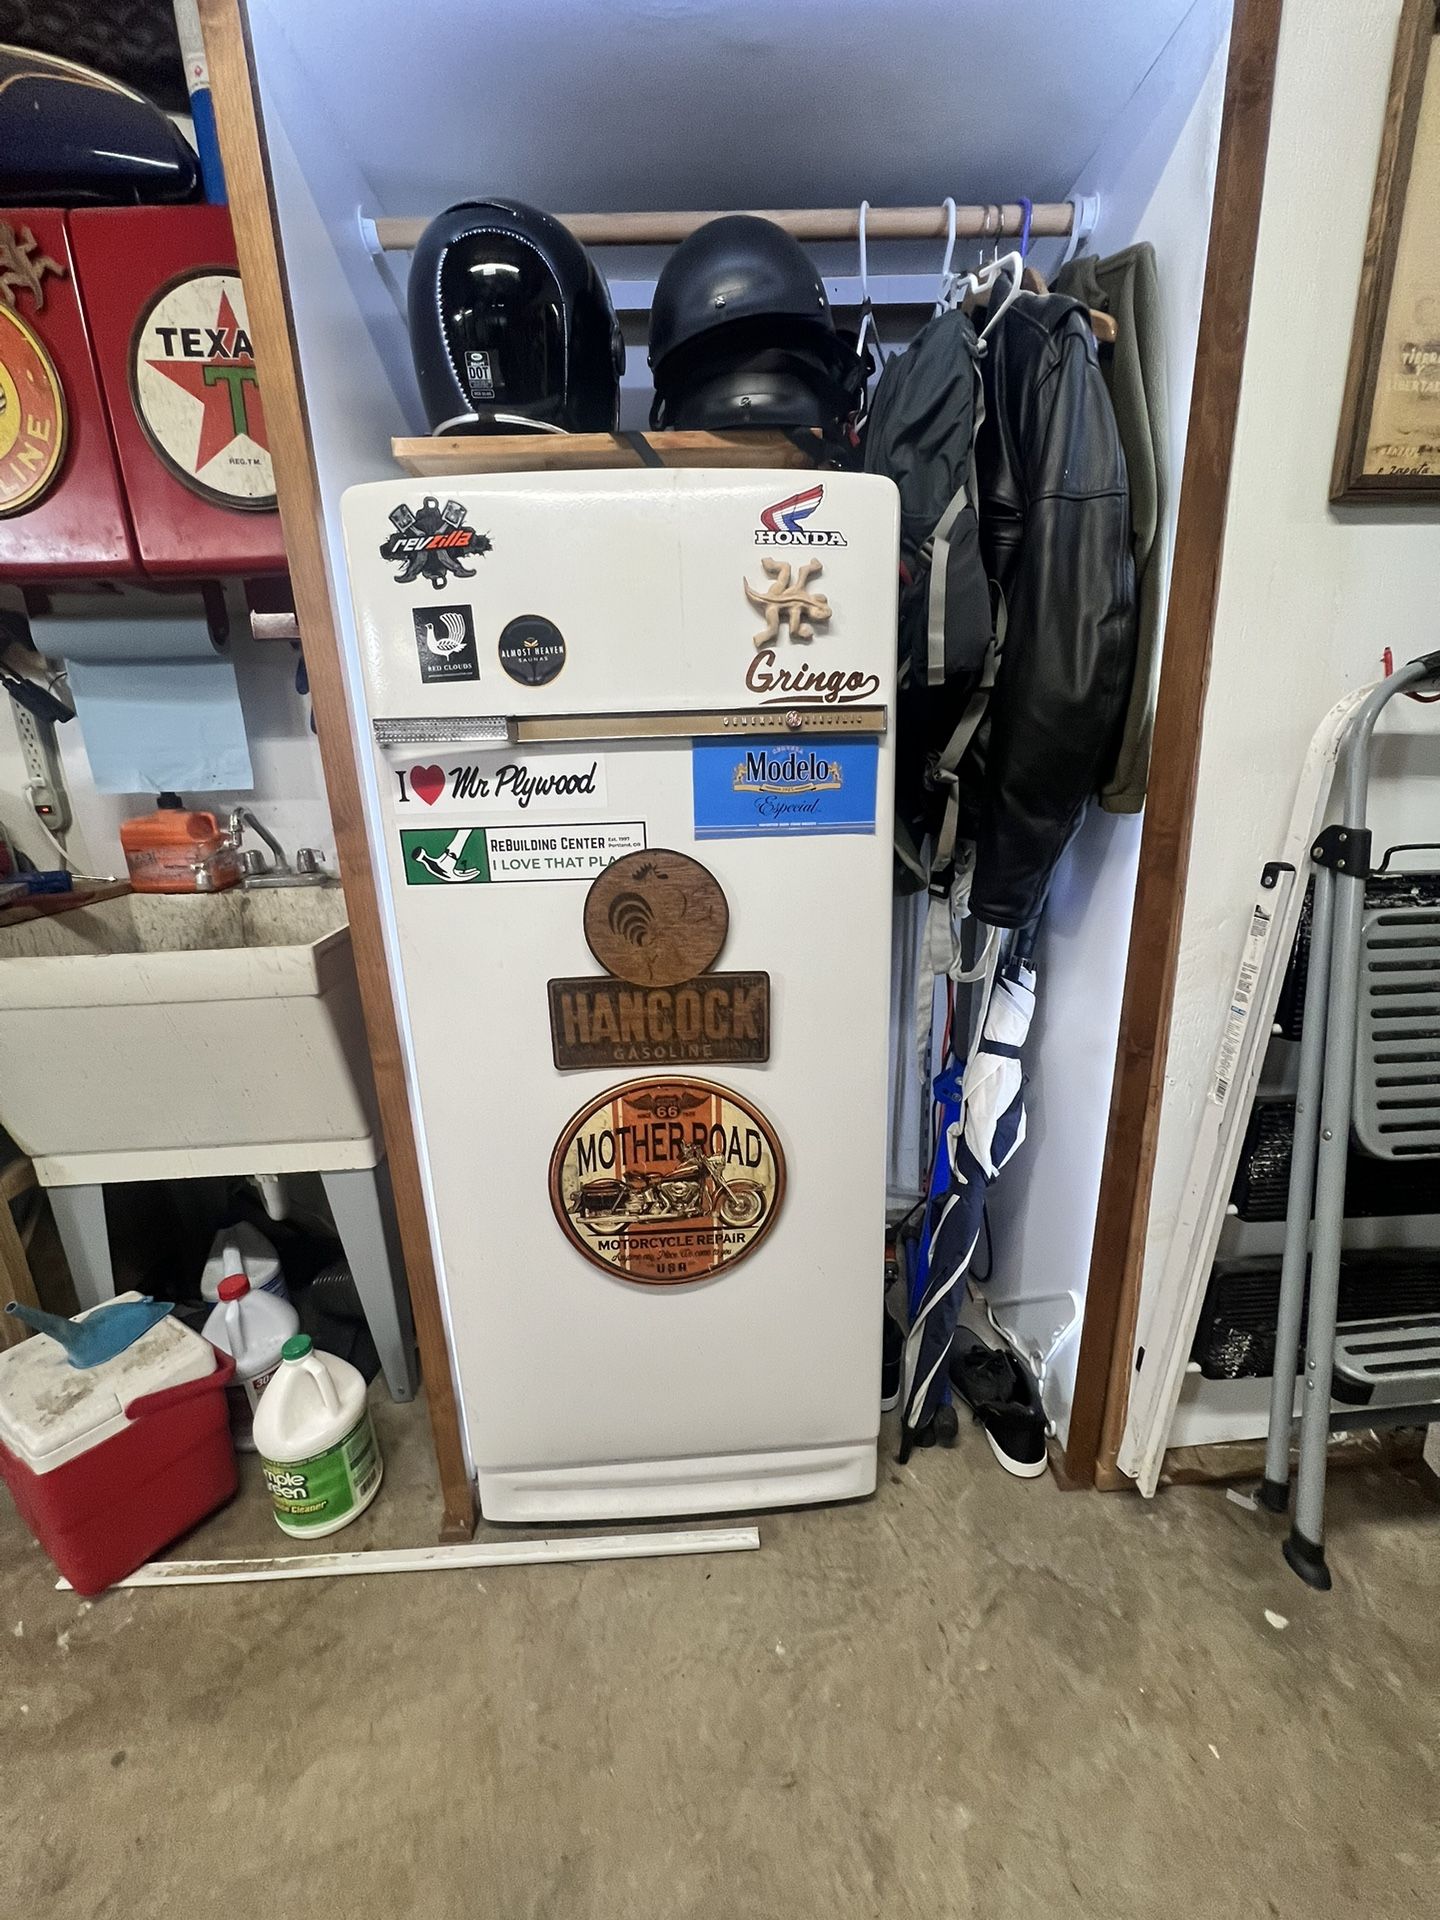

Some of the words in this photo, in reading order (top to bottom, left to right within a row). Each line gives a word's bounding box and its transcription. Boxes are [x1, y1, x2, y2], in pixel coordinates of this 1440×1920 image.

[469, 366, 489, 379] DOT
[755, 530, 848, 546] HONDA
[501, 648, 532, 658] ALMOST
[534, 645, 564, 656] HEAVEN
[443, 662, 473, 671] CLOUDS
[745, 649, 880, 703] Gringo
[745, 751, 830, 782] Modelo
[394, 770, 411, 802] I
[449, 766, 490, 798] Mr
[495, 761, 598, 809] Plywood
[753, 795, 818, 820] Especial
[560, 836, 606, 851] CENTER
[492, 859, 497, 870] I
[501, 857, 542, 870] LOVE
[543, 856, 586, 869] THAT
[588, 855, 625, 868] PLA
[561, 986, 760, 1048] HANCOCK
[613, 1044, 713, 1060] GASOLINE
[656, 1106, 678, 1118] 66
[576, 1122, 685, 1177] MOTHER
[691, 1121, 763, 1170] ROAD
[598, 1236, 694, 1251] MOTORCYCLE
[696, 1232, 746, 1245] REPAIR
[656, 1262, 688, 1274] USA
[291, 1500, 327, 1514] Cleaner
